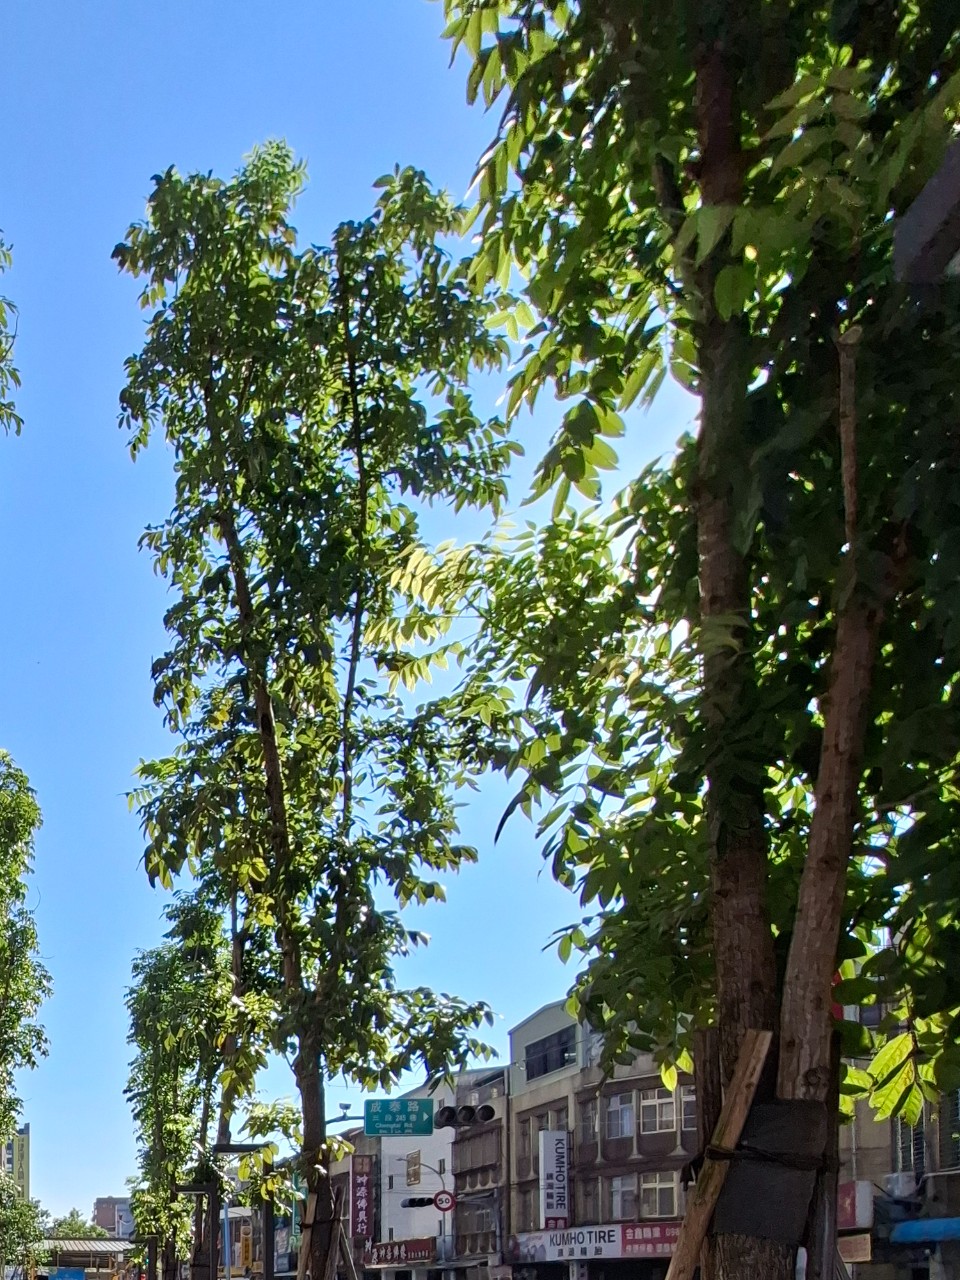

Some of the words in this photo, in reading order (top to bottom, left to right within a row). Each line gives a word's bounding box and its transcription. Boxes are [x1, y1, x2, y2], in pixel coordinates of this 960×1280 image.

[370, 1101, 419, 1113] 成泰路
[555, 1138, 565, 1182] KUMHO
[555, 1184, 566, 1210] TIRE
[549, 1231, 585, 1247] KUMHO
[586, 1229, 616, 1244] TIRE
